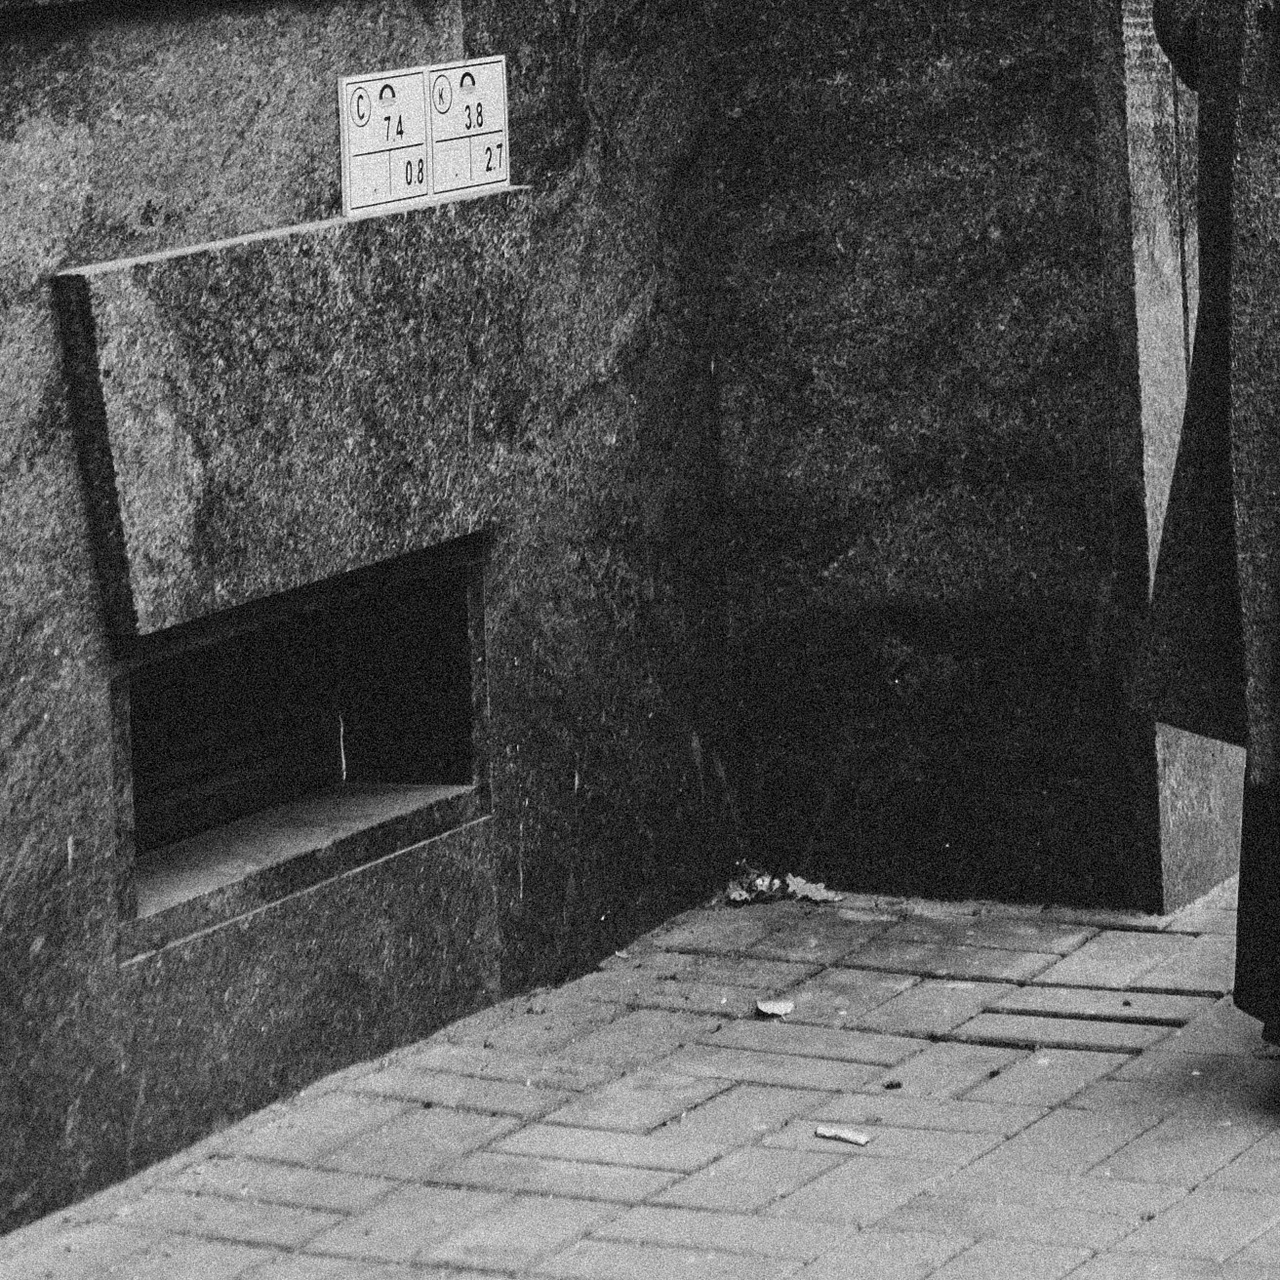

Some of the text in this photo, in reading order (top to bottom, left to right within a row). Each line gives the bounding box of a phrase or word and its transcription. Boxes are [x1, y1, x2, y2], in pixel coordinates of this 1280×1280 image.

[464, 102, 484, 130] 3.8
[405, 158, 424, 185] 0.8
[484, 143, 503, 172] 2.7
